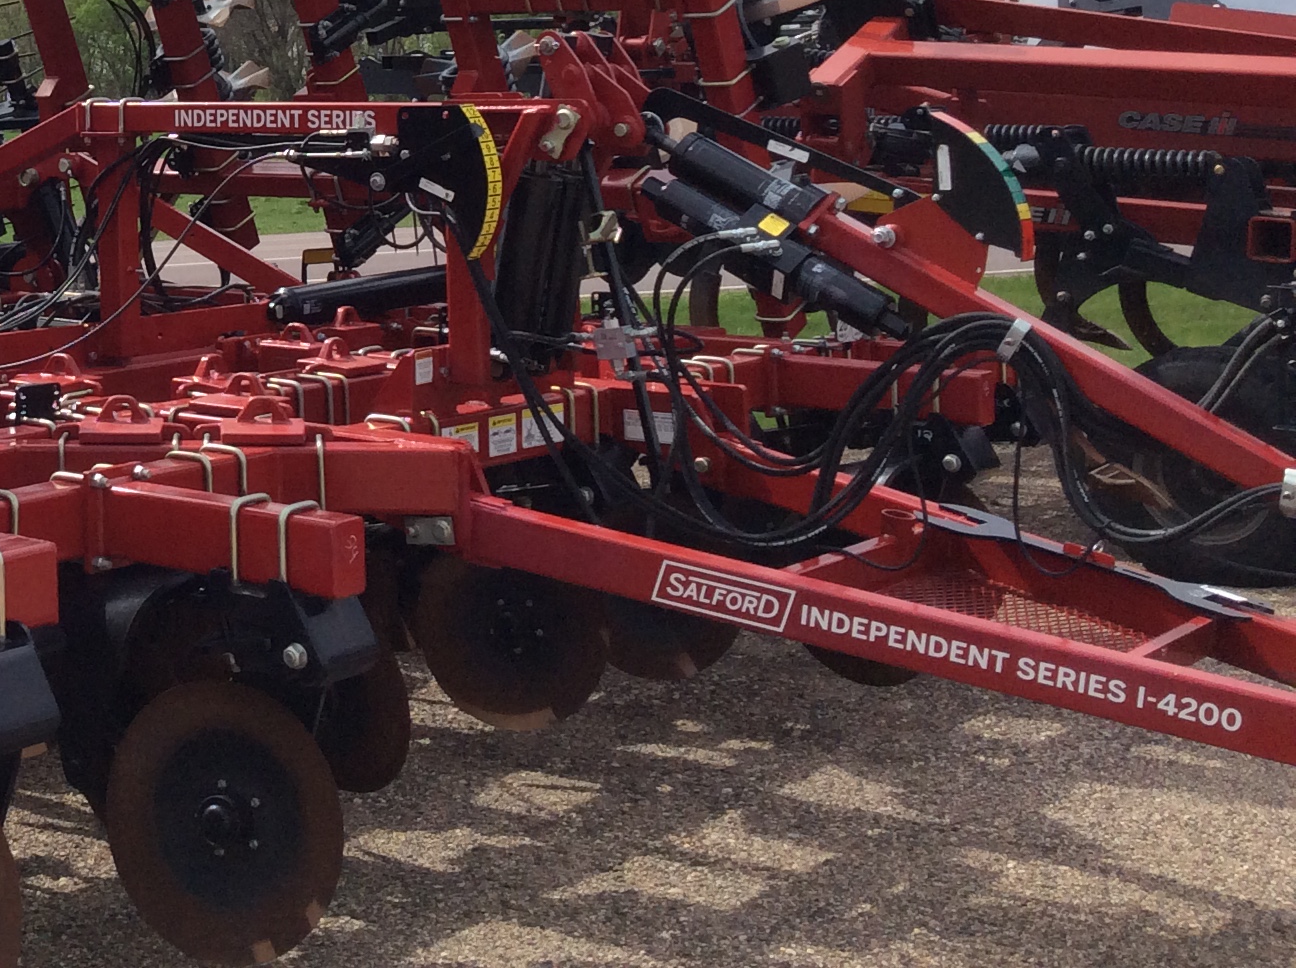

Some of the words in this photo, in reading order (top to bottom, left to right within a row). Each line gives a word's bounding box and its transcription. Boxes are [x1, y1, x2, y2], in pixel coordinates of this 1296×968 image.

[174, 109, 303, 128] INDEPENDENT
[1118, 110, 1204, 133] CASE
[666, 572, 780, 619] SALFORD
[800, 604, 1010, 673] INDEPENDENT
[1016, 657, 1127, 703] SERIES
[1136, 686, 1242, 732] I-4200
